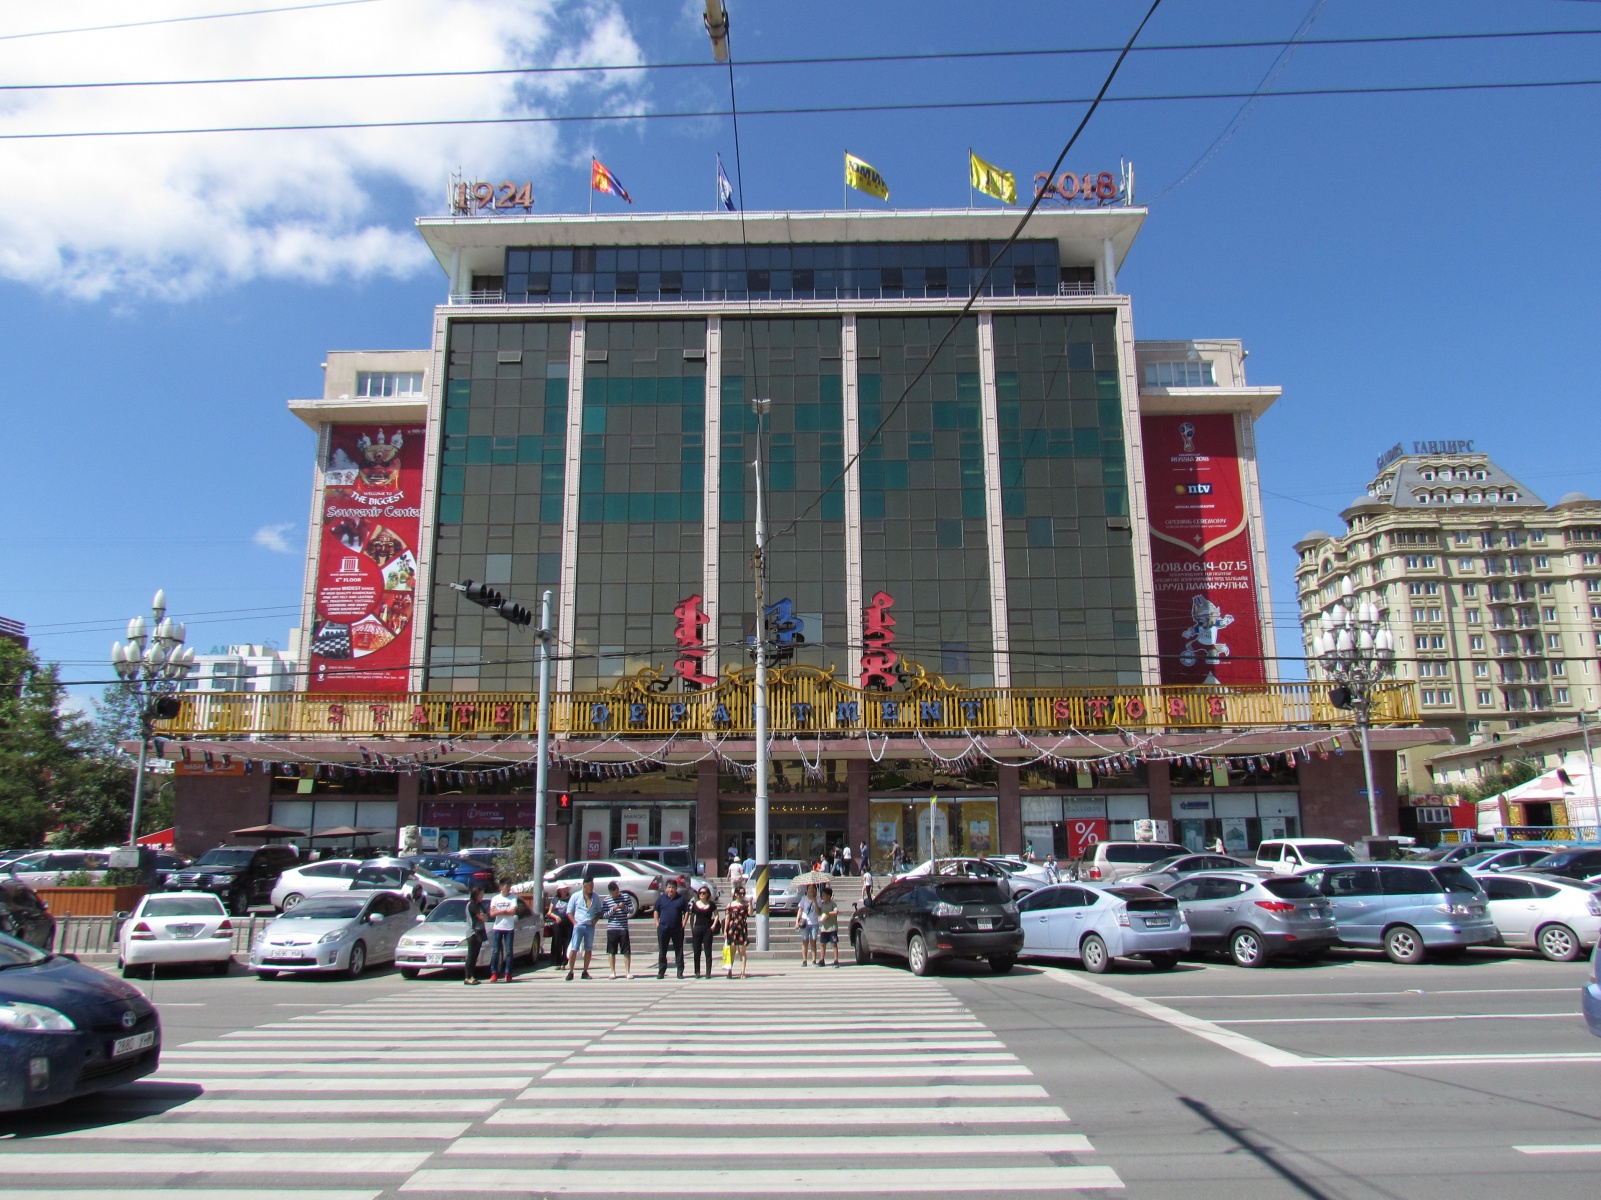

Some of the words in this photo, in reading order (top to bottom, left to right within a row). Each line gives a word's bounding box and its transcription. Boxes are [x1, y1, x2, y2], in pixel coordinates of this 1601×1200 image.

[1034, 171, 1117, 200] 2018
[457, 181, 534, 209] 1924
[1413, 440, 1475, 455] ГАНДИРС
[1188, 483, 1211, 494] ntv
[351, 491, 367, 504] THE
[368, 491, 404, 505] BIGGEST
[327, 505, 383, 518] Souvenir
[1154, 561, 1248, 573] 2018.06.14-07.15
[1156, 582, 1184, 591] ШУУД
[1185, 581, 1249, 591] ДАМЖУУЛНА
[328, 704, 513, 724] STATE
[591, 702, 981, 723] DEPATMENT
[1054, 696, 1227, 720] STORE
[588, 843, 600, 853] 50
